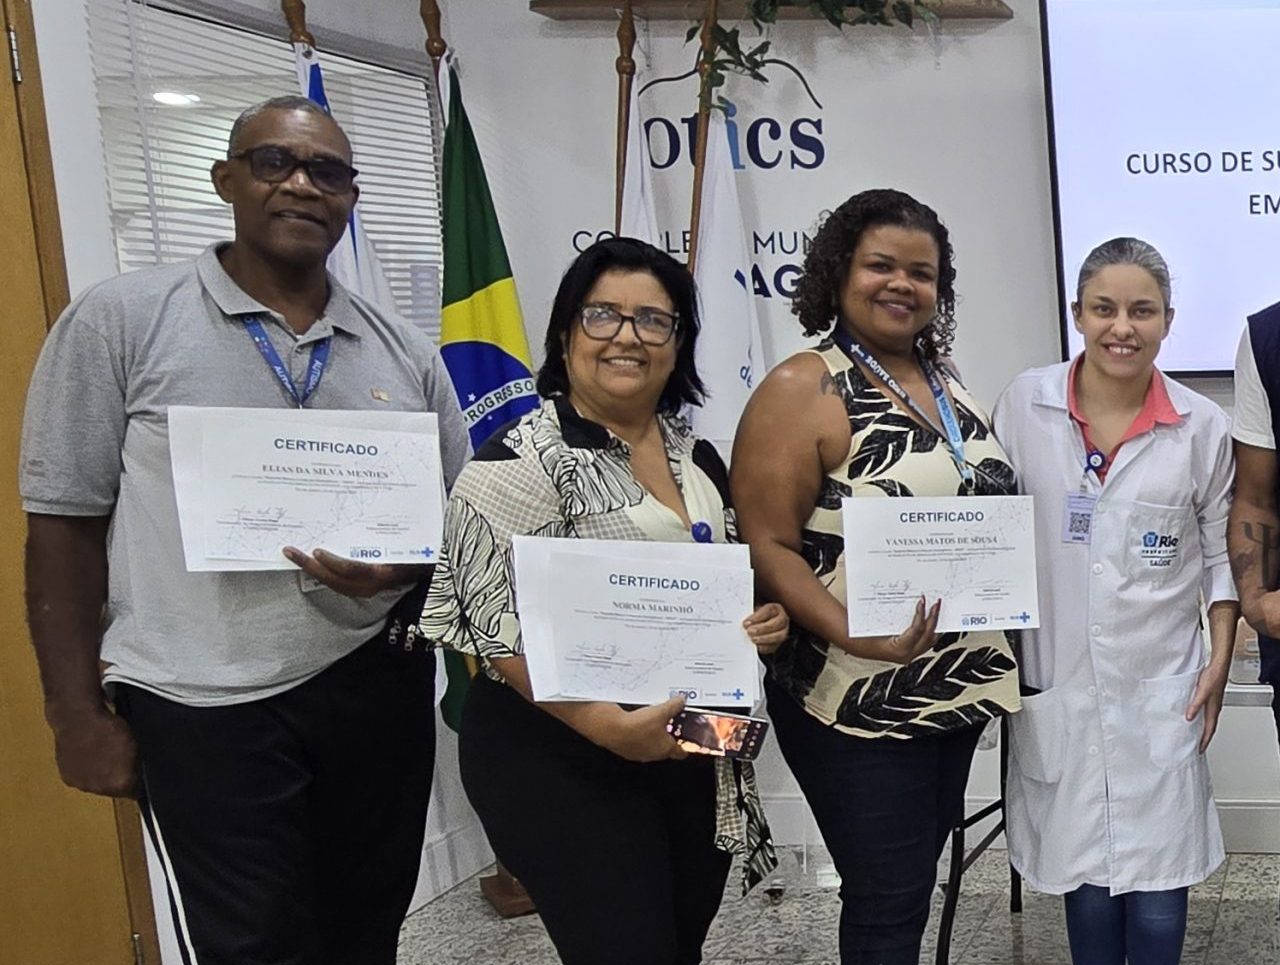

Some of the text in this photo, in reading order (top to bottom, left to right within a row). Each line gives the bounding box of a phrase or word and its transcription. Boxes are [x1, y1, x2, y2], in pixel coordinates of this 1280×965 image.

[1126, 152, 1212, 175] CURSO
[1221, 151, 1254, 172] DE
[273, 437, 379, 457] CERTIFICADO
[262, 464, 390, 479] ELIAS DA SILVA MENDES
[900, 511, 984, 523] CERTIFICADO
[925, 537, 956, 546] MATOS
[360, 549, 382, 558] RIO
[609, 573, 700, 591] CERTIFICADO
[612, 601, 646, 612] NORMA
[971, 616, 987, 625] RIO
